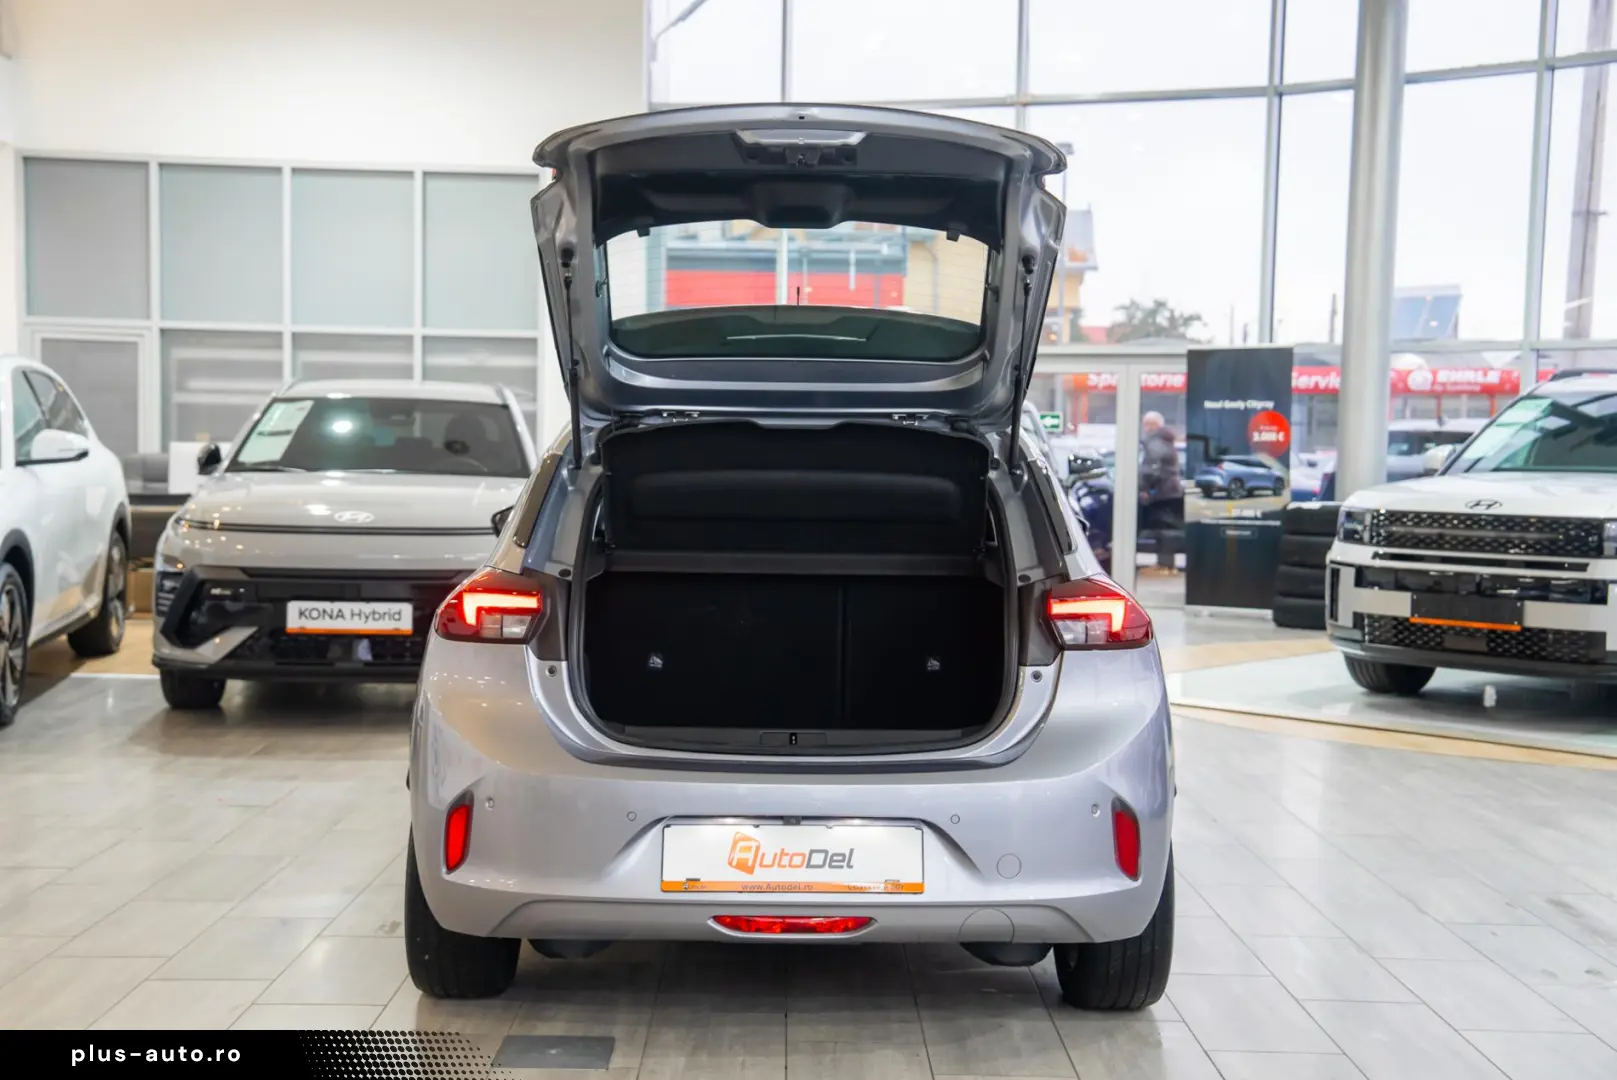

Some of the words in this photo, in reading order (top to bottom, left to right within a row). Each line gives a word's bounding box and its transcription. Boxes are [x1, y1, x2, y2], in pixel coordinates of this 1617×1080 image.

[298, 607, 346, 620] KONA
[351, 608, 402, 623] Hybrid
[729, 833, 855, 874] AutoDel
